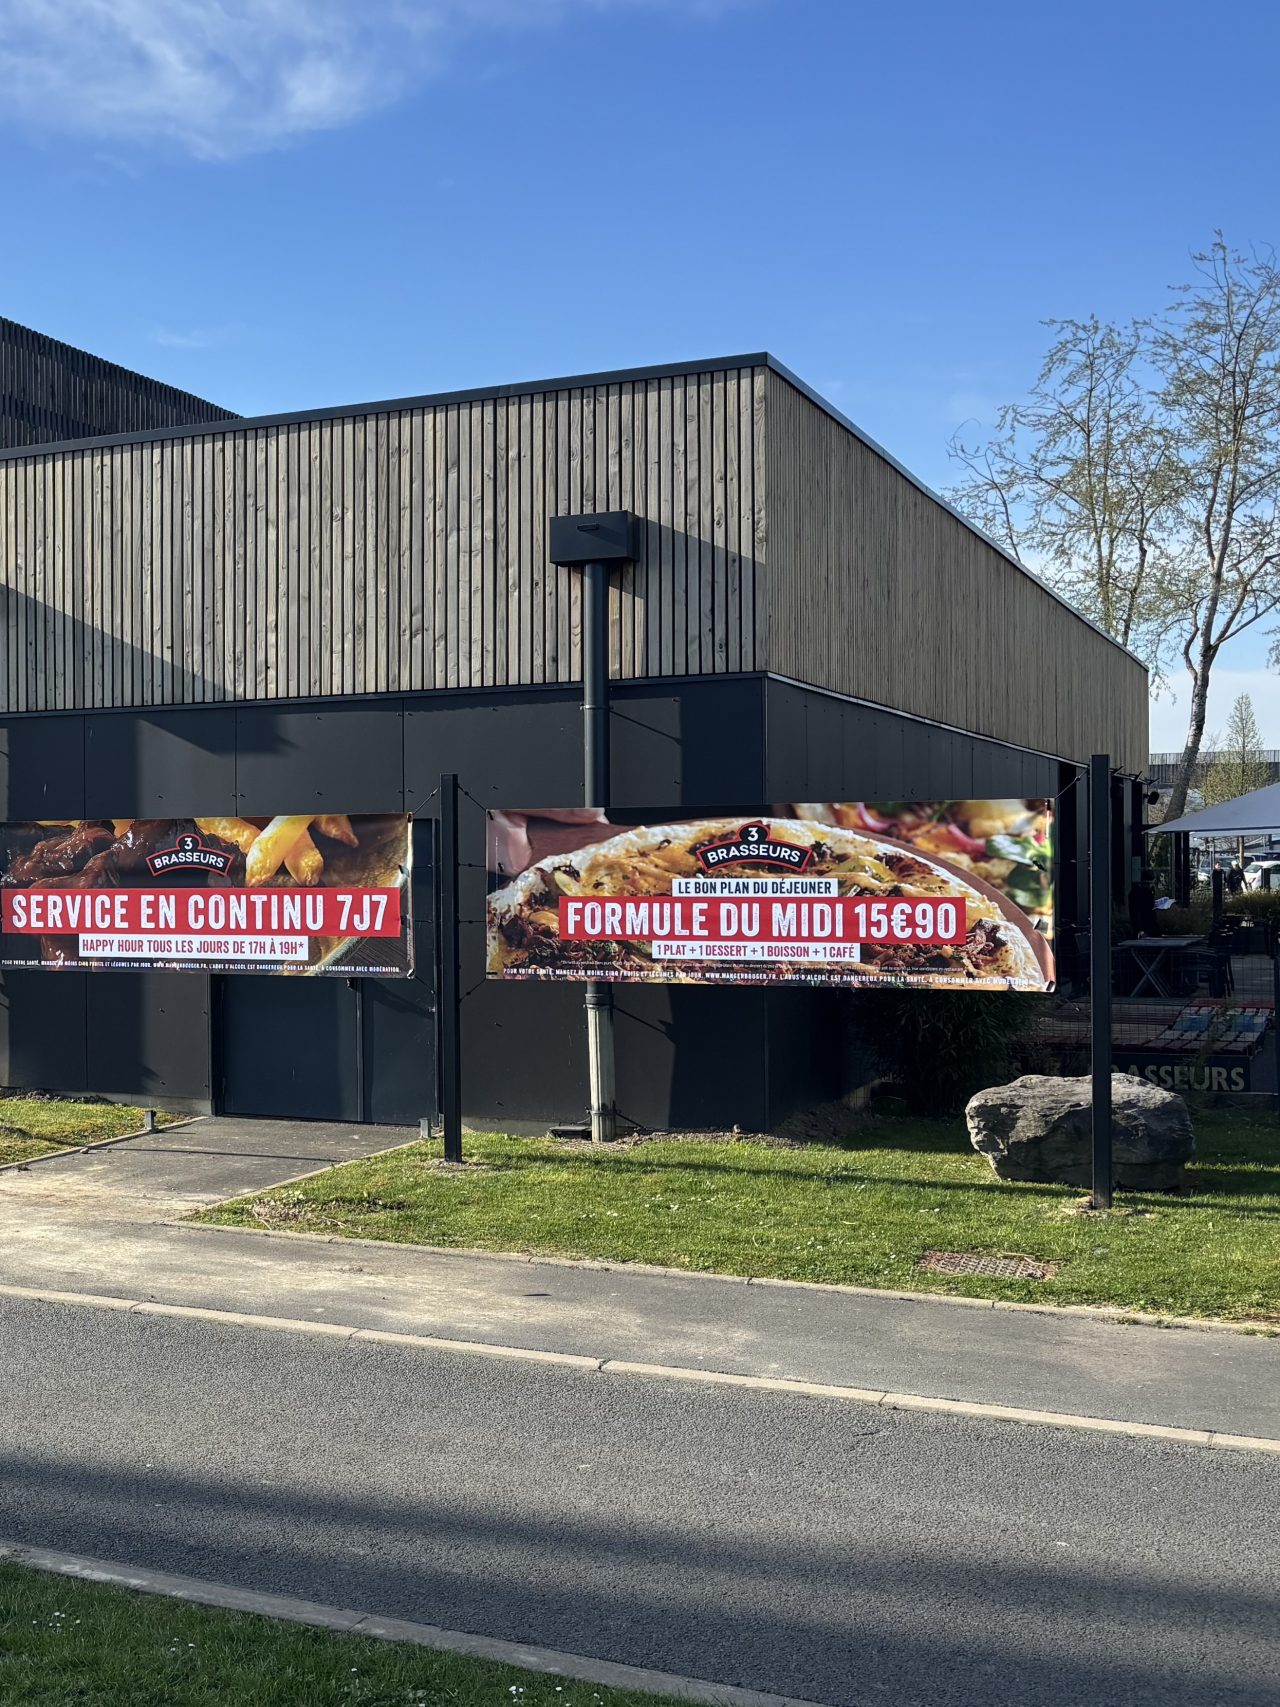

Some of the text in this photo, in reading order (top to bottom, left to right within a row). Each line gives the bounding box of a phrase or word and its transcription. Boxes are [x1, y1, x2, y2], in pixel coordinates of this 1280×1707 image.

[747, 827, 759, 842] 3
[184, 837, 193, 850] 3
[153, 852, 225, 869] BRASSEURS
[706, 843, 801, 864] BRASSEURS
[678, 878, 832, 895] LE BON PLAN DU DÉJEUNER
[12, 894, 388, 931] SERVICE EN CONTINU 7J7
[567, 901, 957, 939] FORMULE DU MIDI 15€90
[82, 938, 114, 953] HAPPY
[117, 939, 144, 953] HOUR
[146, 939, 173, 953] TOUS
[175, 940, 194, 954] LES
[196, 940, 229, 954] JOURS
[233, 940, 246, 954] DE
[248, 940, 266, 955] 17H
[270, 938, 276, 955] À
[664, 944, 687, 956] PLAT
[705, 945, 748, 957] DESSERT
[767, 946, 810, 958] BOISSON
[830, 944, 855, 958] CAFÉ
[1088, 1063, 1246, 1091] SSEURS
